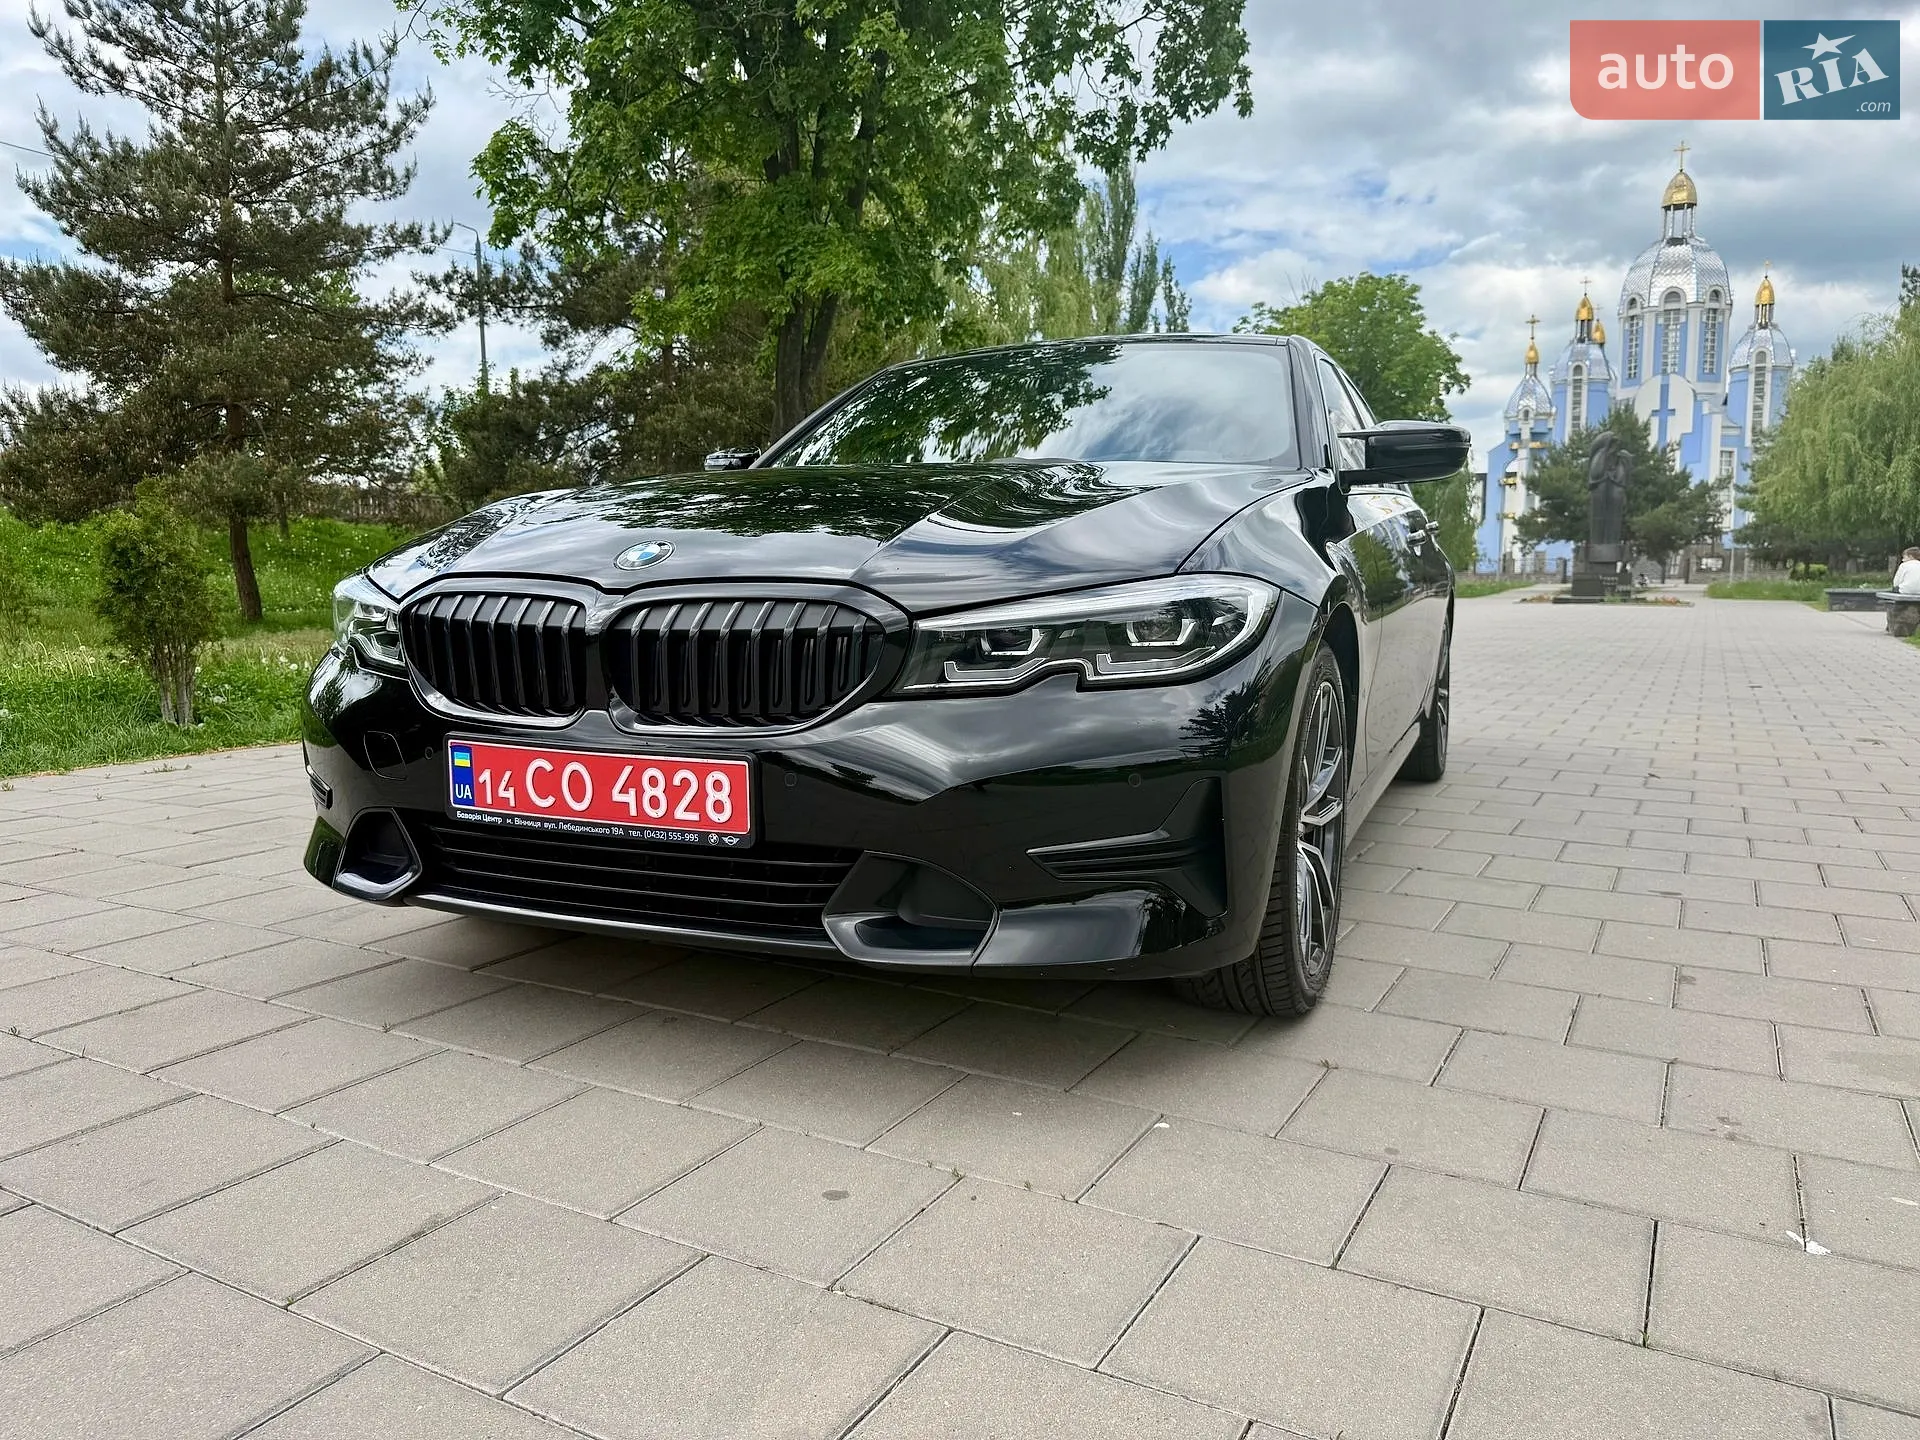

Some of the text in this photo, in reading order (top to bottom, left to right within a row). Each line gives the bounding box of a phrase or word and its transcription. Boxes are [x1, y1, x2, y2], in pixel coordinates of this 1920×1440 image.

[455, 783, 473, 800] UA
[478, 758, 733, 824] 14 CO 4828
[482, 813, 503, 825] Центр
[514, 817, 541, 828] Вінниця
[558, 821, 611, 834] Лебединського
[628, 830, 643, 838] тел.
[644, 829, 667, 841] (0432)
[668, 832, 699, 842] 555-995
